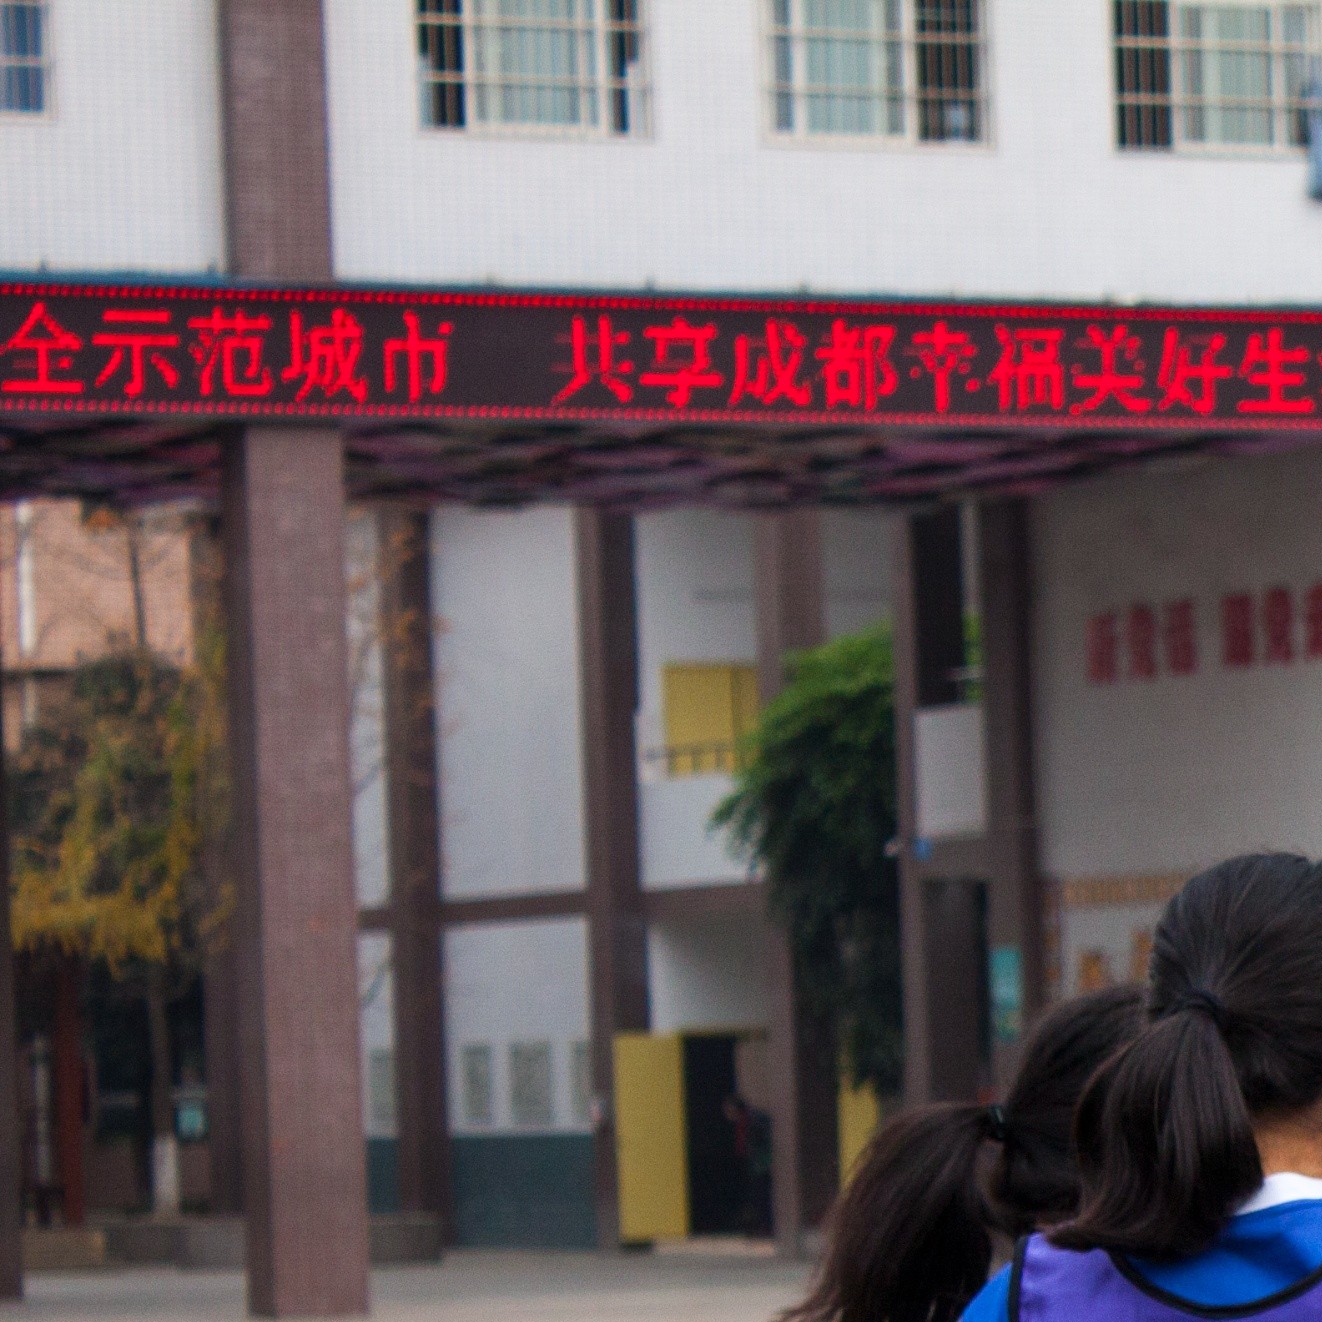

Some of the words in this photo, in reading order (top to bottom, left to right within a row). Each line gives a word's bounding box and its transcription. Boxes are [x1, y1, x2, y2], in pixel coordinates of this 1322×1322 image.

[0, 301, 453, 402] 全示范城市
